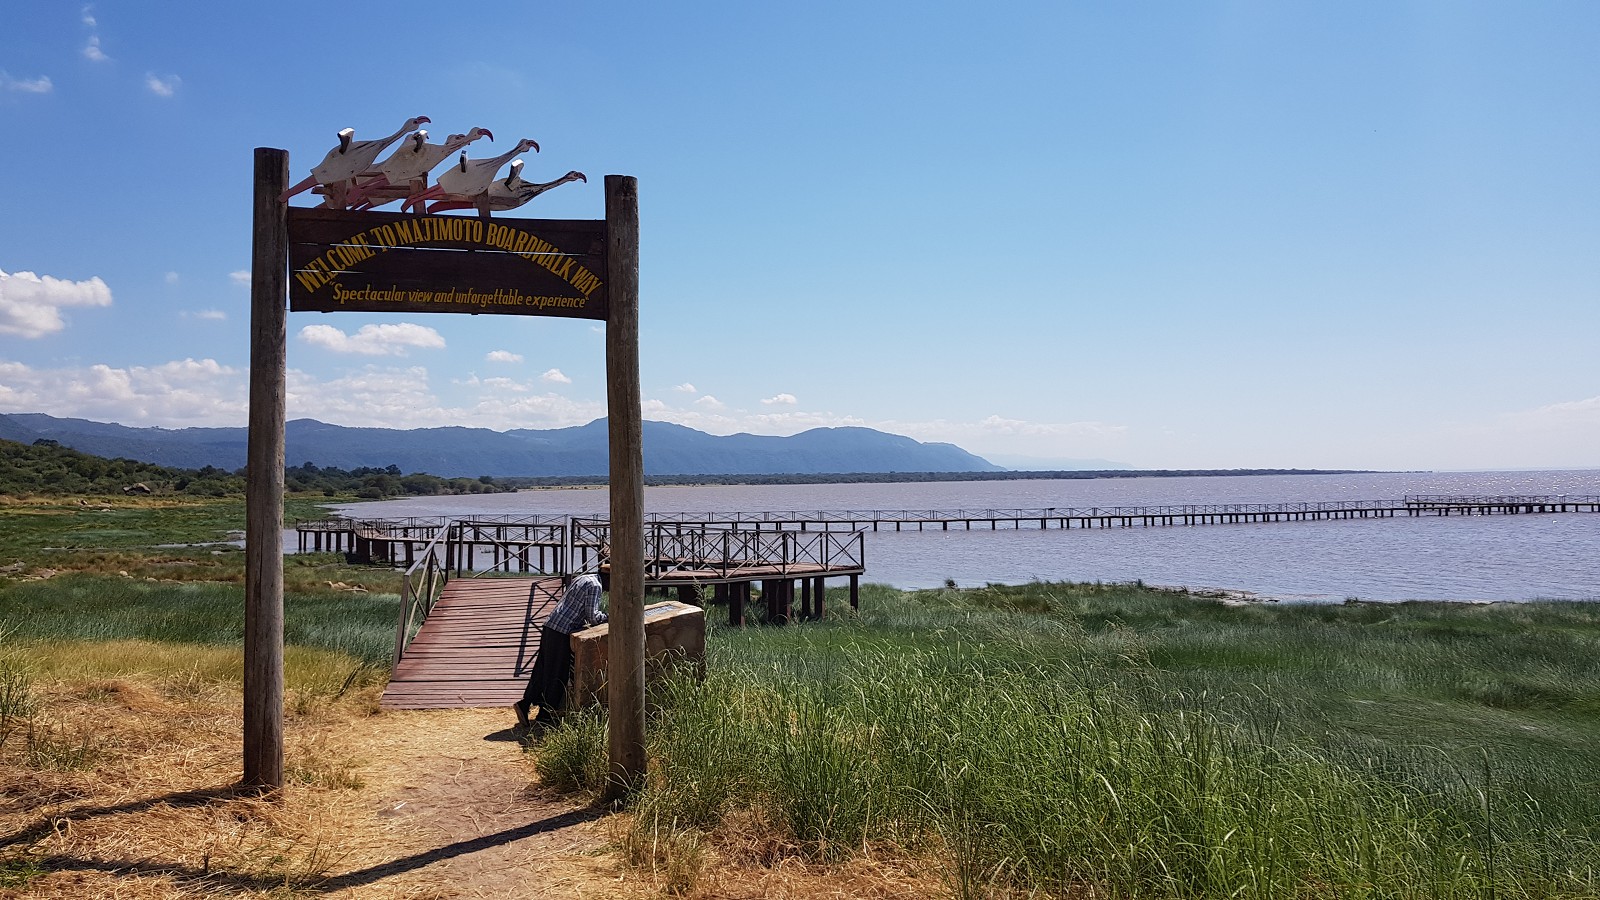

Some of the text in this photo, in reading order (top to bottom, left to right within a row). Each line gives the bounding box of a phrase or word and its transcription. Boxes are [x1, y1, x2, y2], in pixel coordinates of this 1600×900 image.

[295, 217, 603, 295] WELCOME TO MAJIMOTO BOARDWALK WAY
[408, 289, 433, 303] view
[434, 287, 456, 303] and
[455, 287, 524, 308] unforgettable
